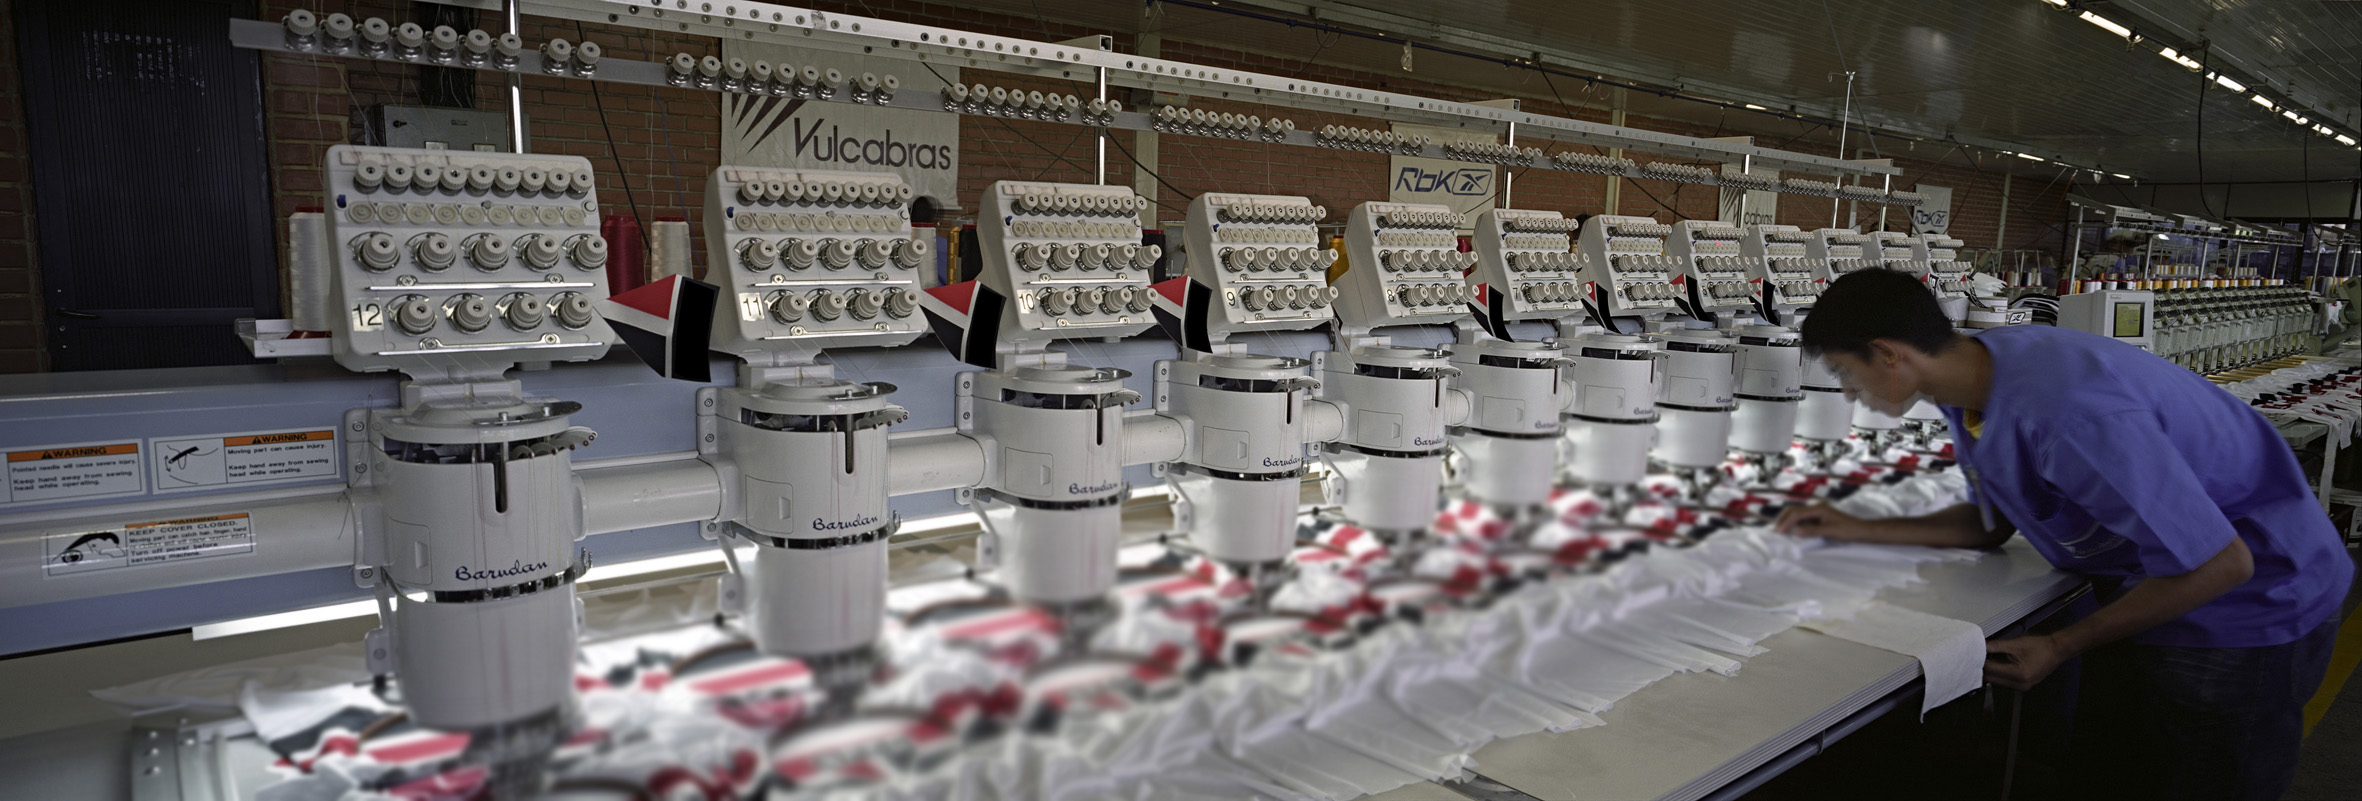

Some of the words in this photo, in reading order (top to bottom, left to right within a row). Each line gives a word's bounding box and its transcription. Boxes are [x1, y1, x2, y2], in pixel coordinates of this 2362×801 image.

[794, 117, 951, 170] Vulcabras
[1018, 293, 1035, 310] 10
[1226, 291, 1236, 307] 9
[1386, 288, 1395, 302] 8
[1512, 287, 1519, 300] 7
[352, 303, 382, 327] 12
[743, 297, 762, 317] 11
[261, 433, 308, 444] WARNING
[53, 446, 107, 458] WARNING
[253, 446, 268, 454] part
[13, 478, 35, 486] Keep
[38, 475, 57, 483] hand
[106, 470, 133, 478] sewing
[269, 467, 302, 475] operating.
[38, 482, 58, 490] while
[62, 480, 100, 489] operating.
[1068, 479, 1119, 495] Barudan
[129, 528, 156, 537] KEEP
[160, 525, 193, 534] COVER
[197, 520, 239, 530] CLOSED.
[812, 513, 879, 531] Barudan
[130, 549, 150, 557] Turn
[455, 559, 548, 581] Barudan
